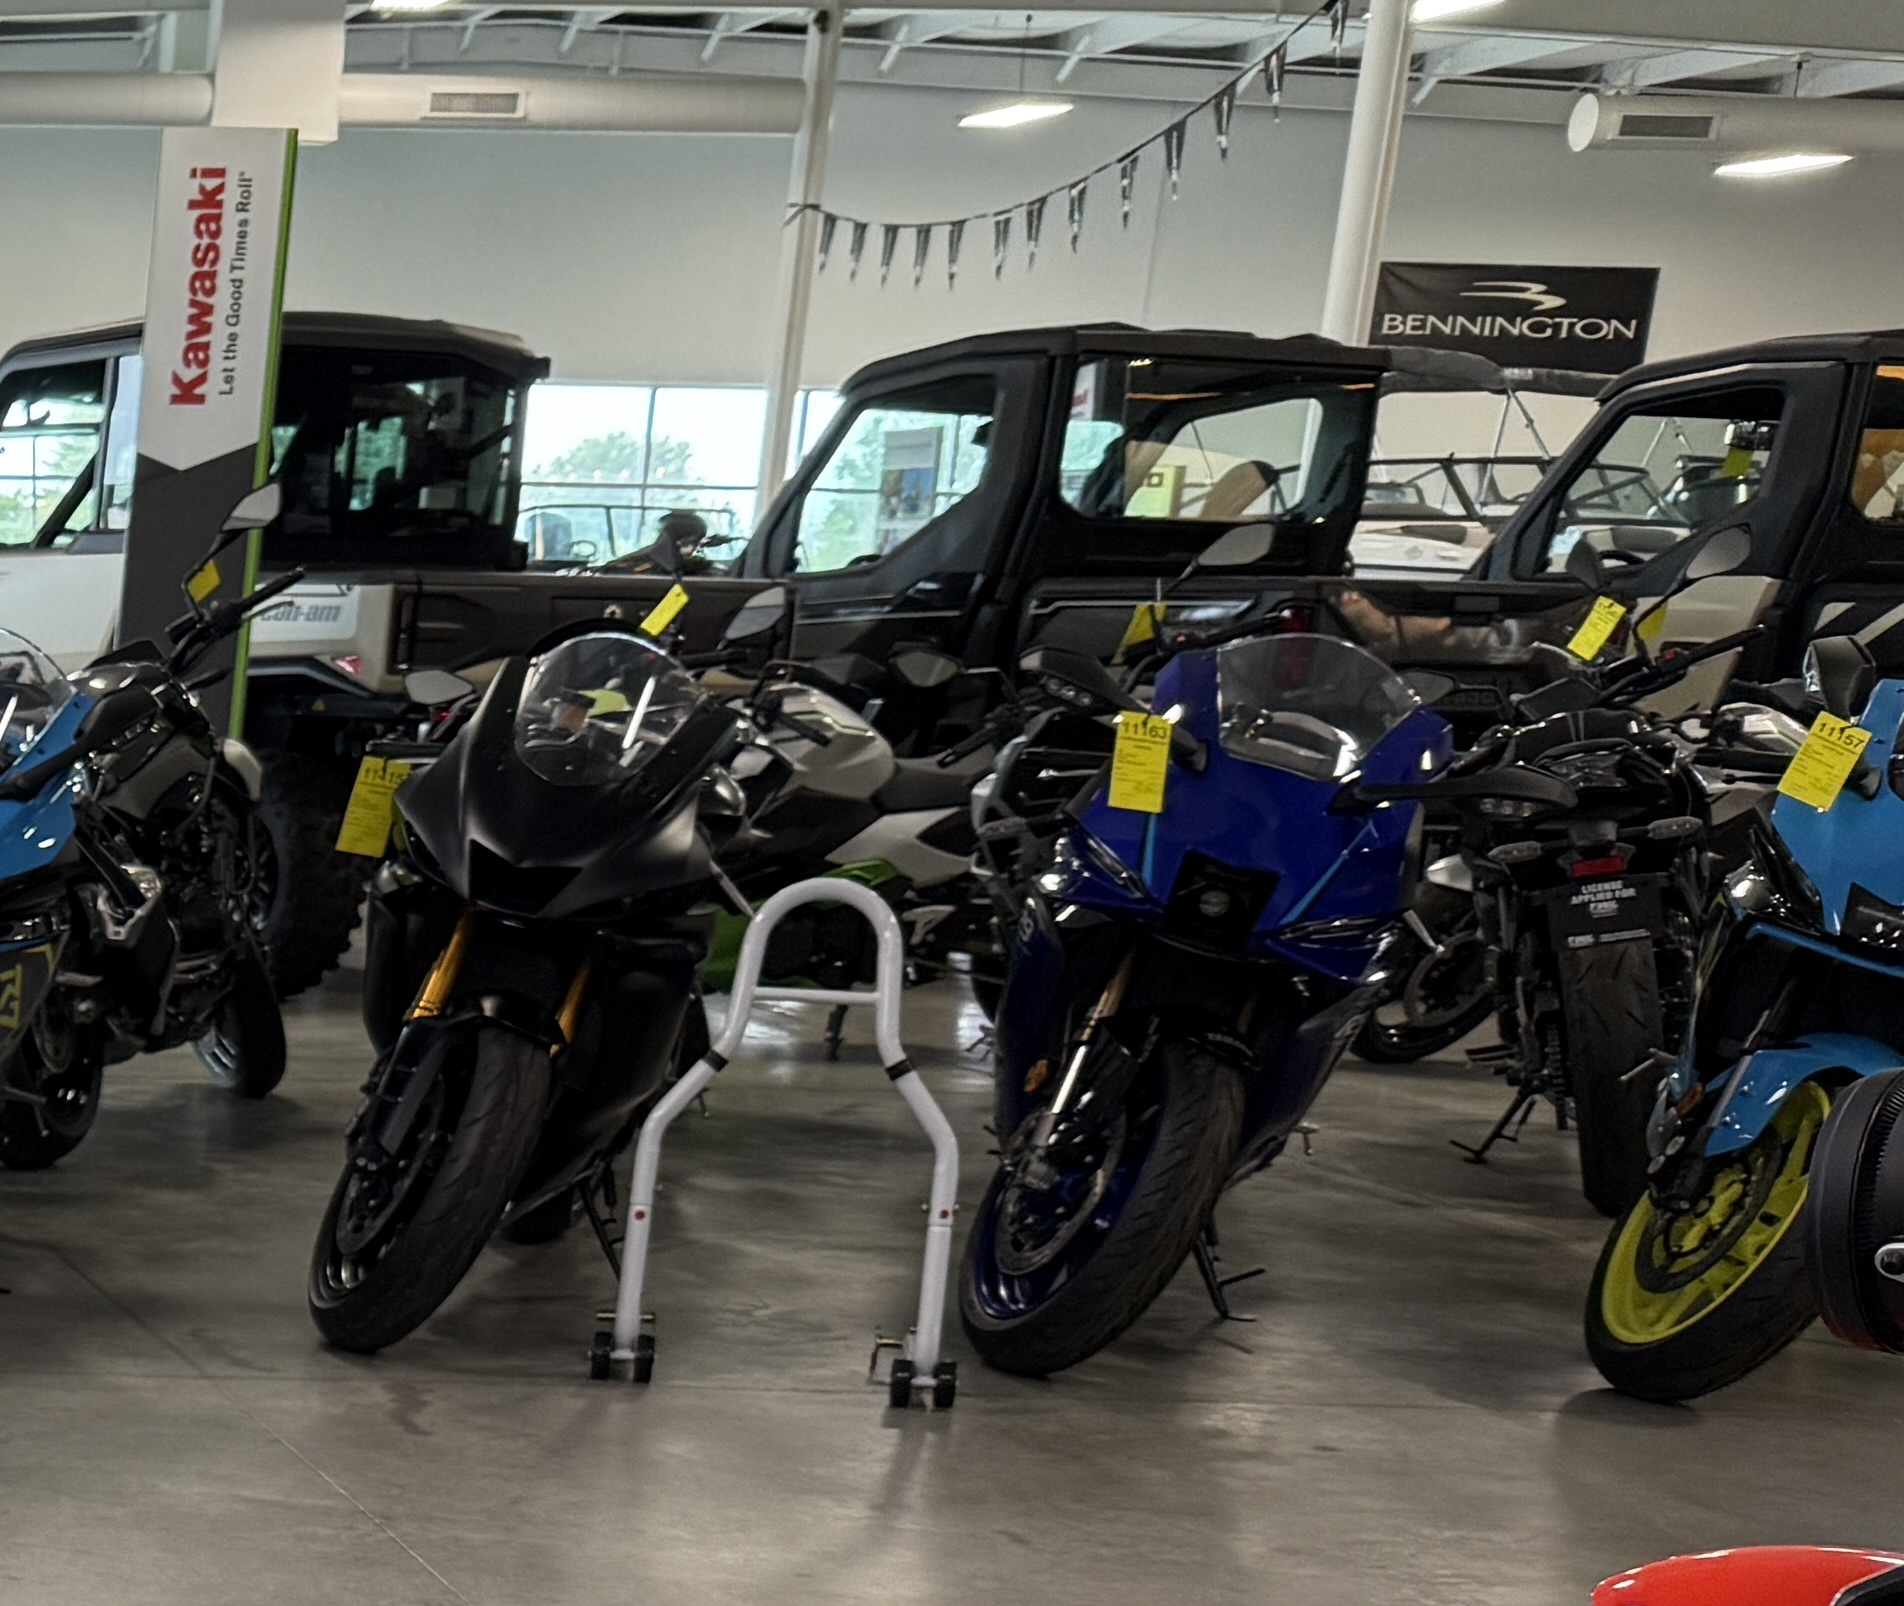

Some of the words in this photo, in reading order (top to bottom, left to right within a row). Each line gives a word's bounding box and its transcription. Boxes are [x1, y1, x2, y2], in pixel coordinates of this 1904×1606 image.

[230, 218, 249, 274] Times
[168, 167, 227, 405] Kawasaki
[225, 278, 244, 327] Good
[222, 331, 239, 361] the
[1381, 313, 1638, 340] BENNINGTON
[219, 367, 235, 396] Let
